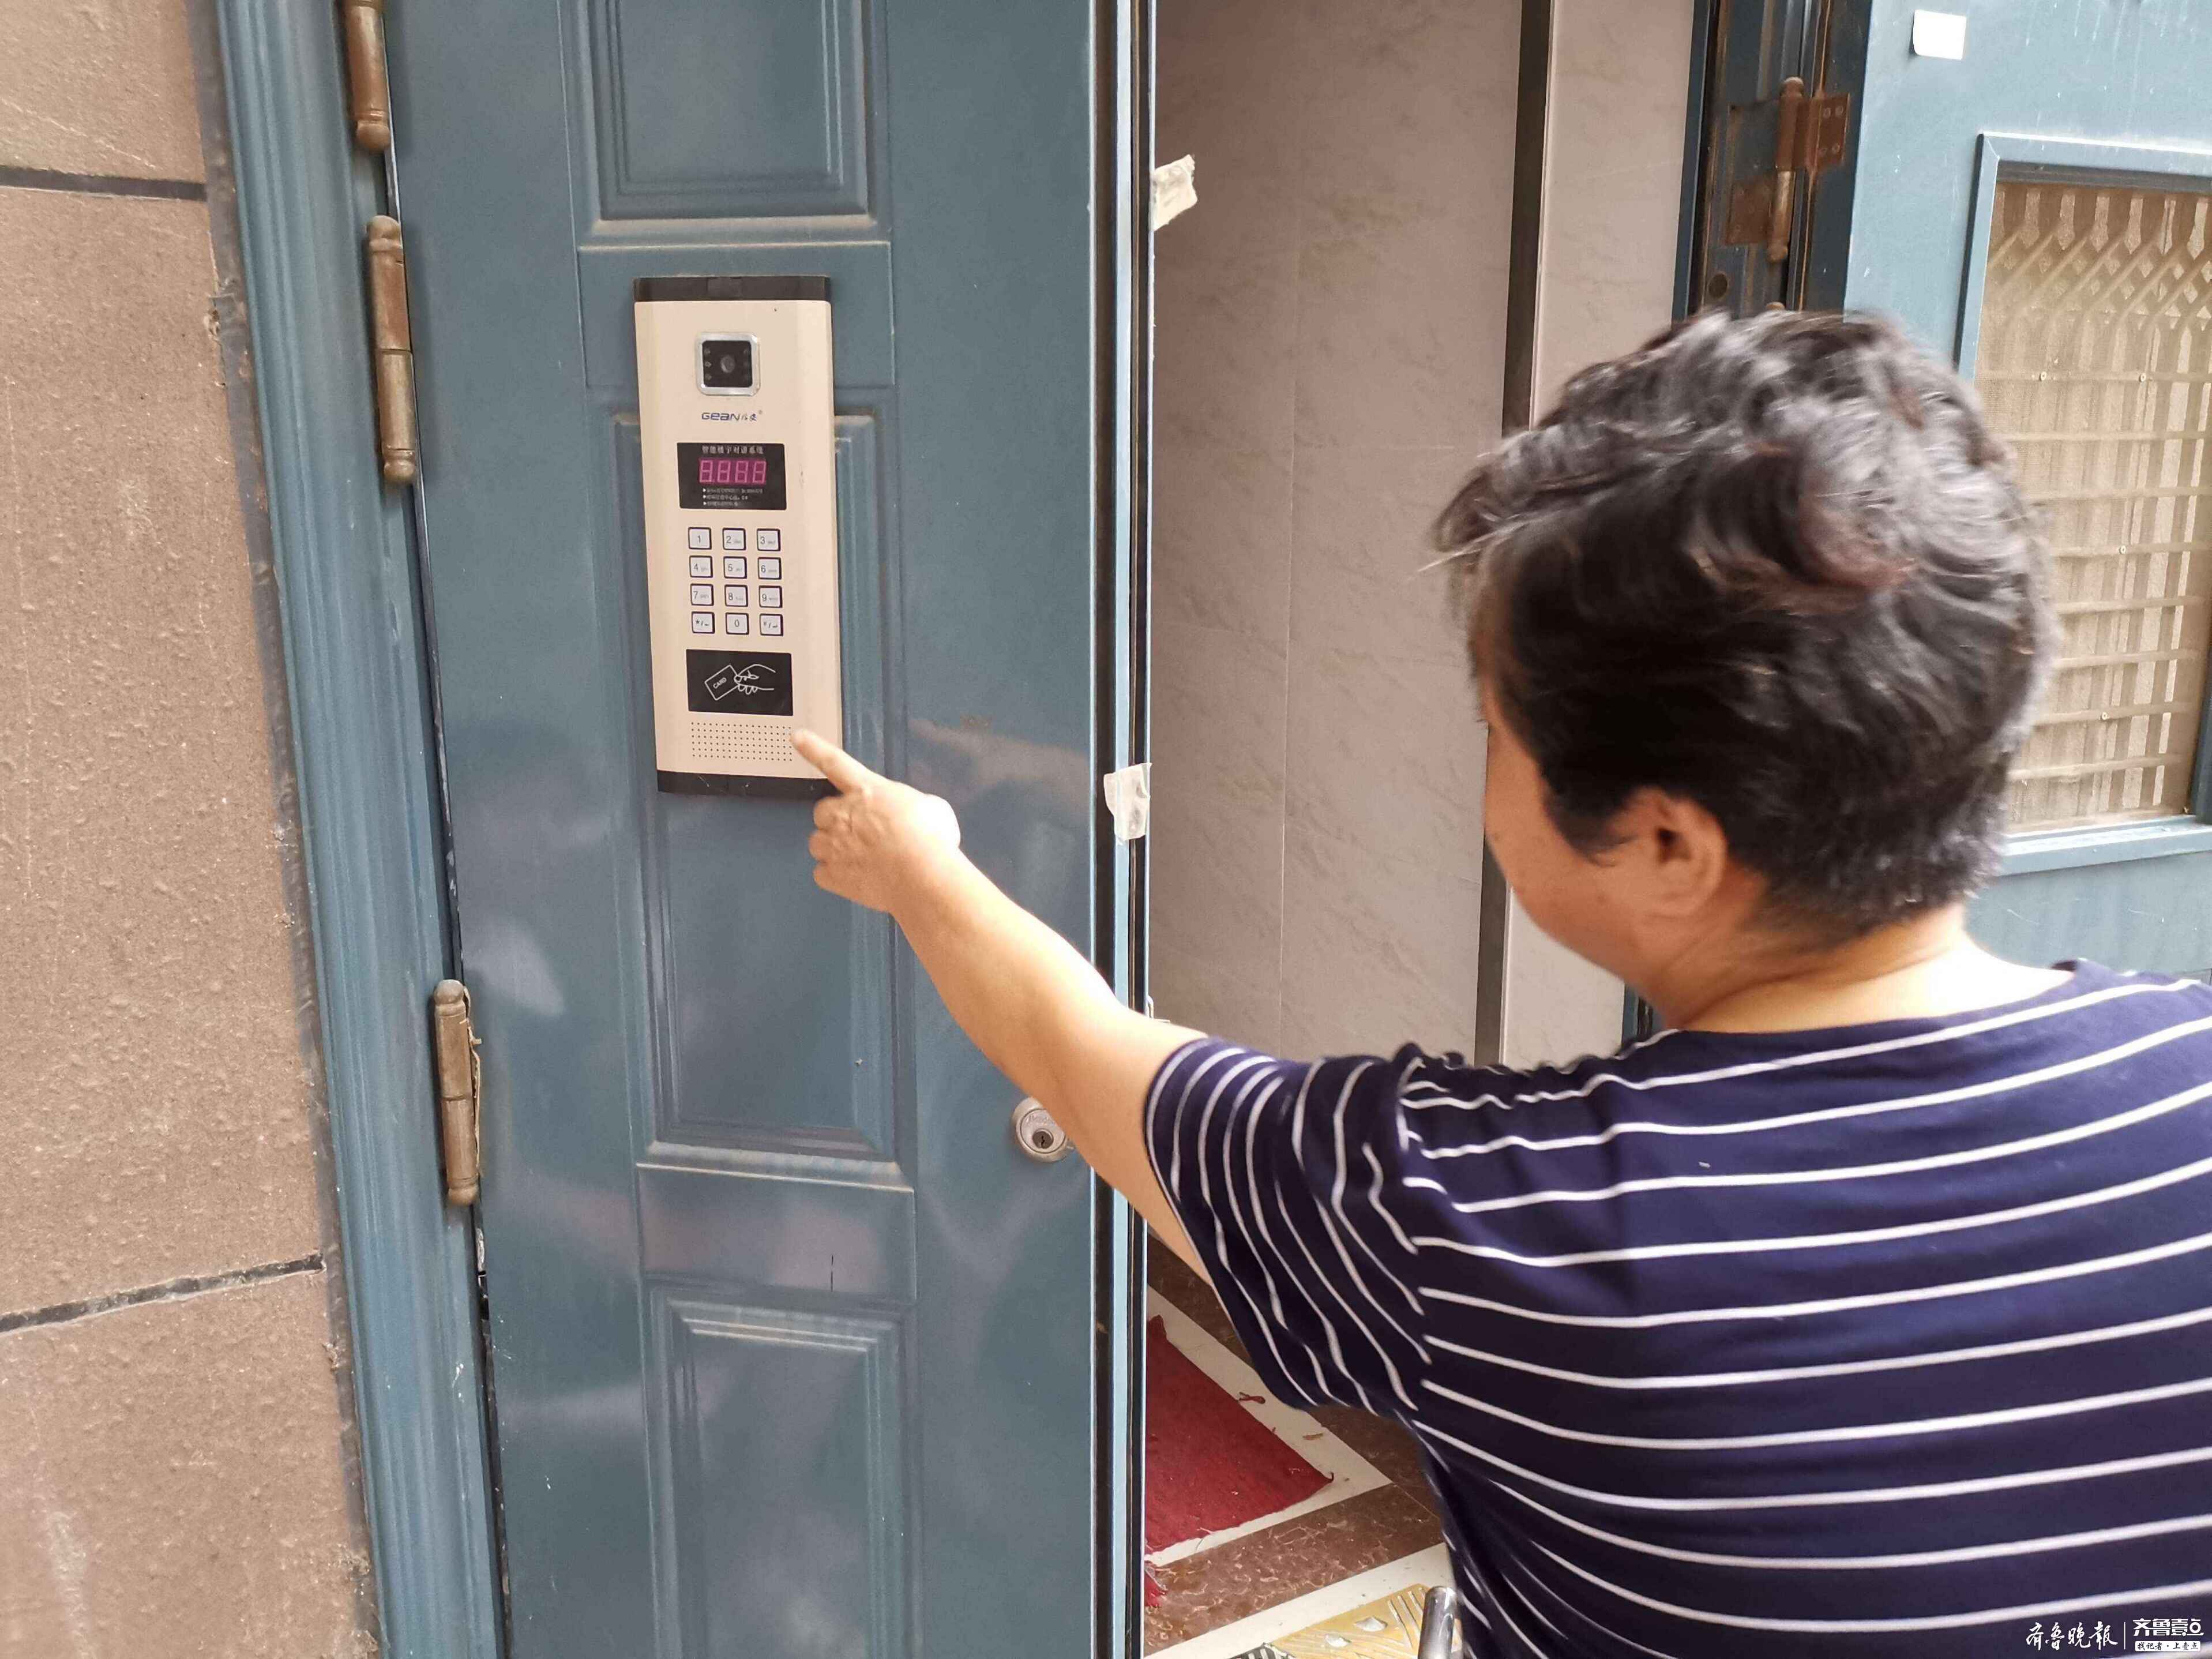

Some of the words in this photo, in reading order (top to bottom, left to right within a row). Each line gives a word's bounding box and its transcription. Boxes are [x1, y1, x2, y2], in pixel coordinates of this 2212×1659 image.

[697, 535, 701, 544] 1
[726, 535, 732, 544] 2
[760, 536, 766, 545] 3
[693, 564, 699, 572] 4
[728, 564, 733, 572] 5
[761, 565, 767, 573] 6
[693, 591, 698, 599] 7
[728, 592, 734, 600] 8
[761, 594, 767, 602] 9
[734, 619, 740, 627] 0
[713, 677, 727, 689] CARD
